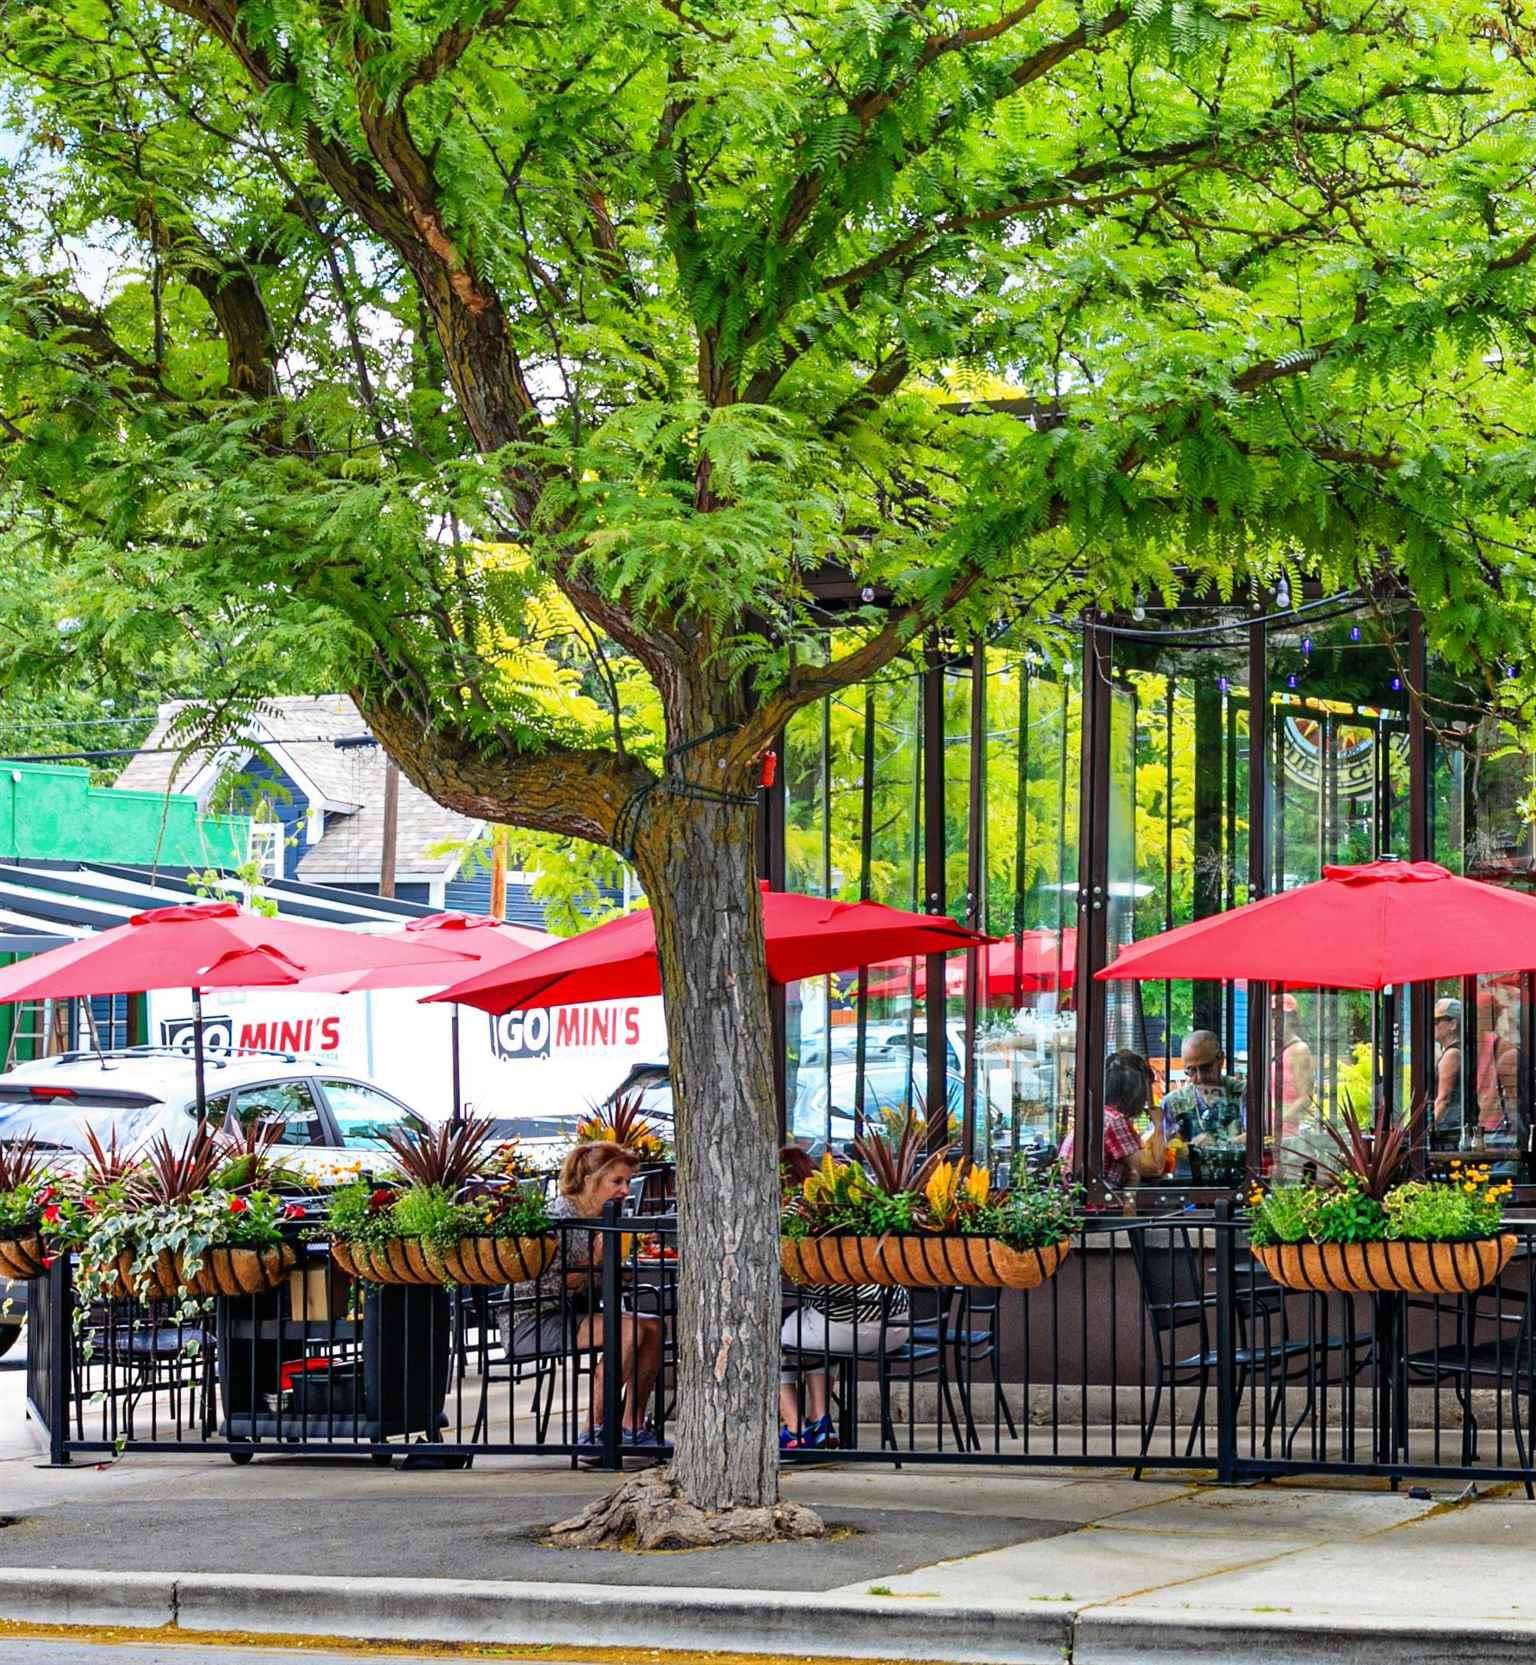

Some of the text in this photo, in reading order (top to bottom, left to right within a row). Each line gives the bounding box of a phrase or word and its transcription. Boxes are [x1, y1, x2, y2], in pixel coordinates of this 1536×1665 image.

[171, 1016, 341, 1057] GO MINI'S
[498, 1006, 640, 1051] GO MINI'S
